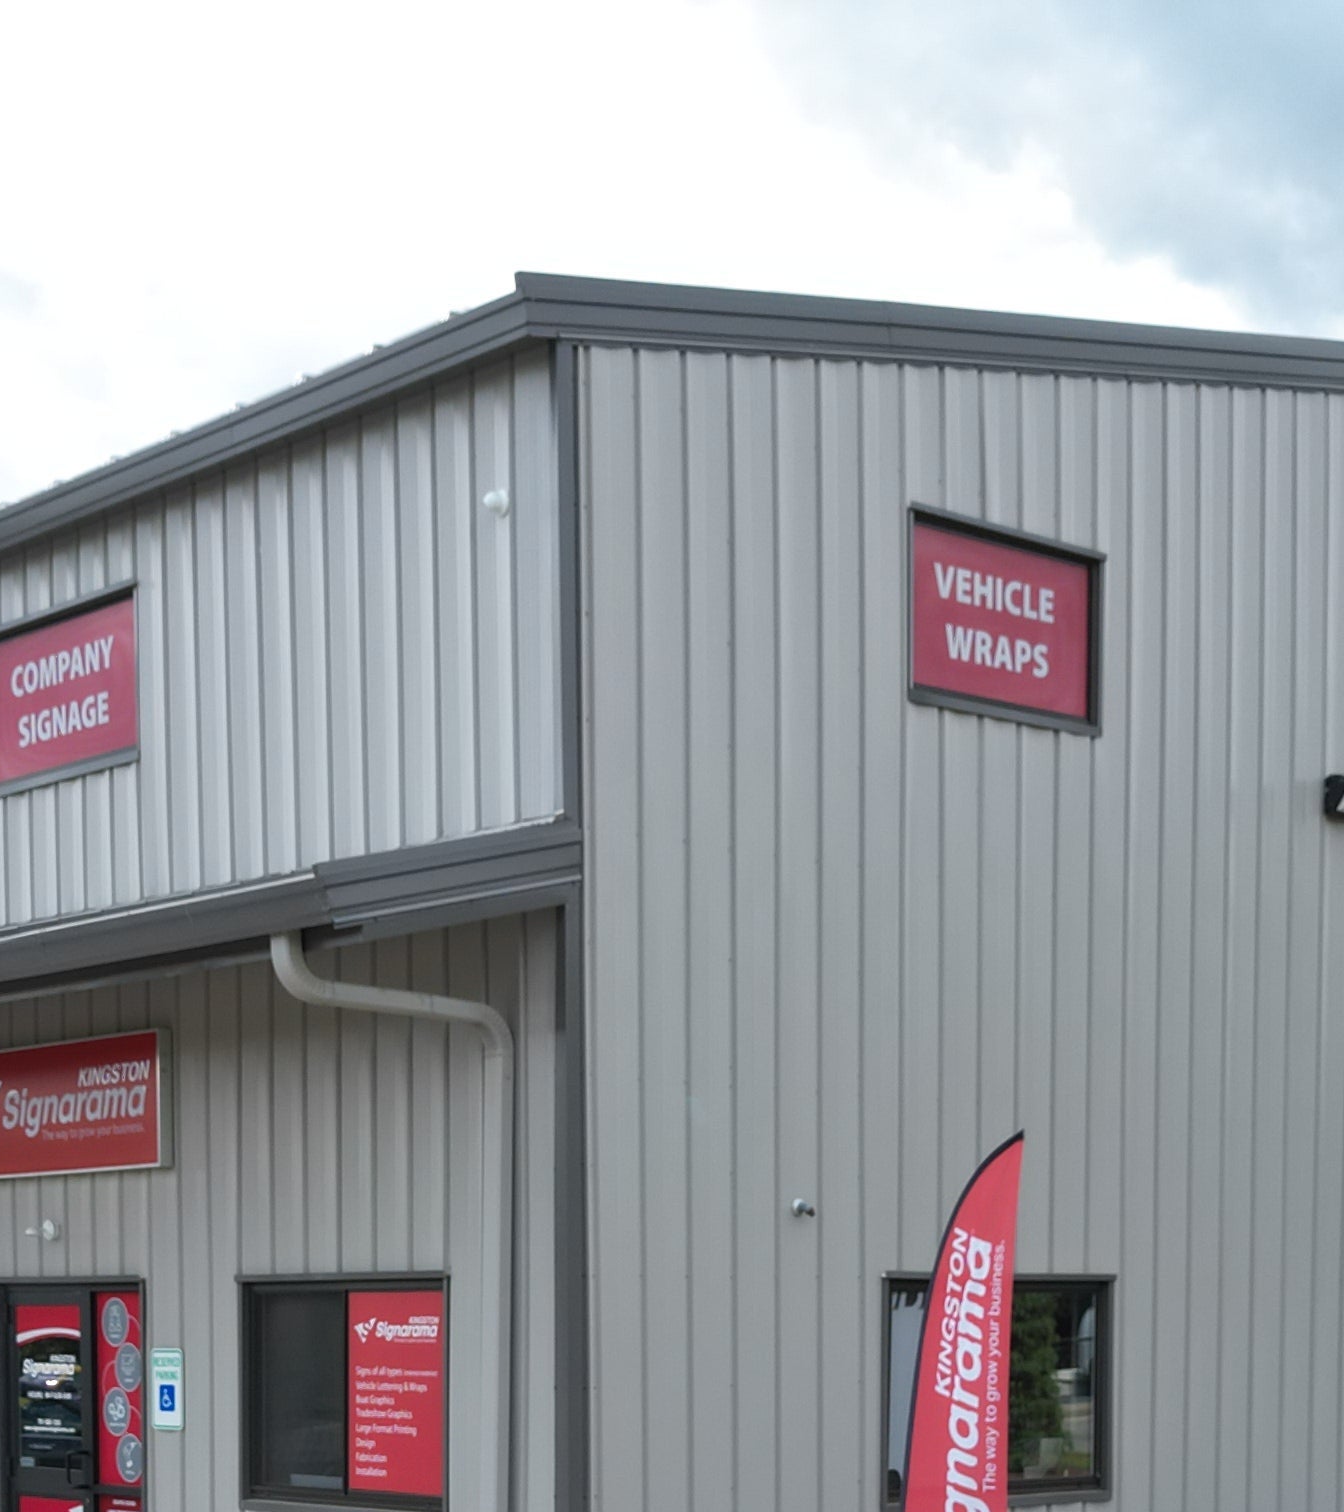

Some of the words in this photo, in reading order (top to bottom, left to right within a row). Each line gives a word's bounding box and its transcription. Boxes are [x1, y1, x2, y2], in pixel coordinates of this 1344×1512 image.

[934, 562, 1055, 624] VEHICLE
[10, 635, 114, 698] COMPANY
[945, 623, 1049, 678] WRAPS
[18, 691, 110, 748] SIGNAGE
[78, 1059, 151, 1087] KINGSTON
[2, 1085, 147, 1138] Signarama
[987, 1239, 1006, 1317] business.
[375, 1321, 439, 1342] Signarama
[934, 1227, 969, 1398] KINGSTON
[987, 1319, 1002, 1358] your
[986, 1361, 1002, 1401] grow
[985, 1405, 998, 1423] to
[984, 1427, 1000, 1462] way
[982, 1464, 997, 1492] The
